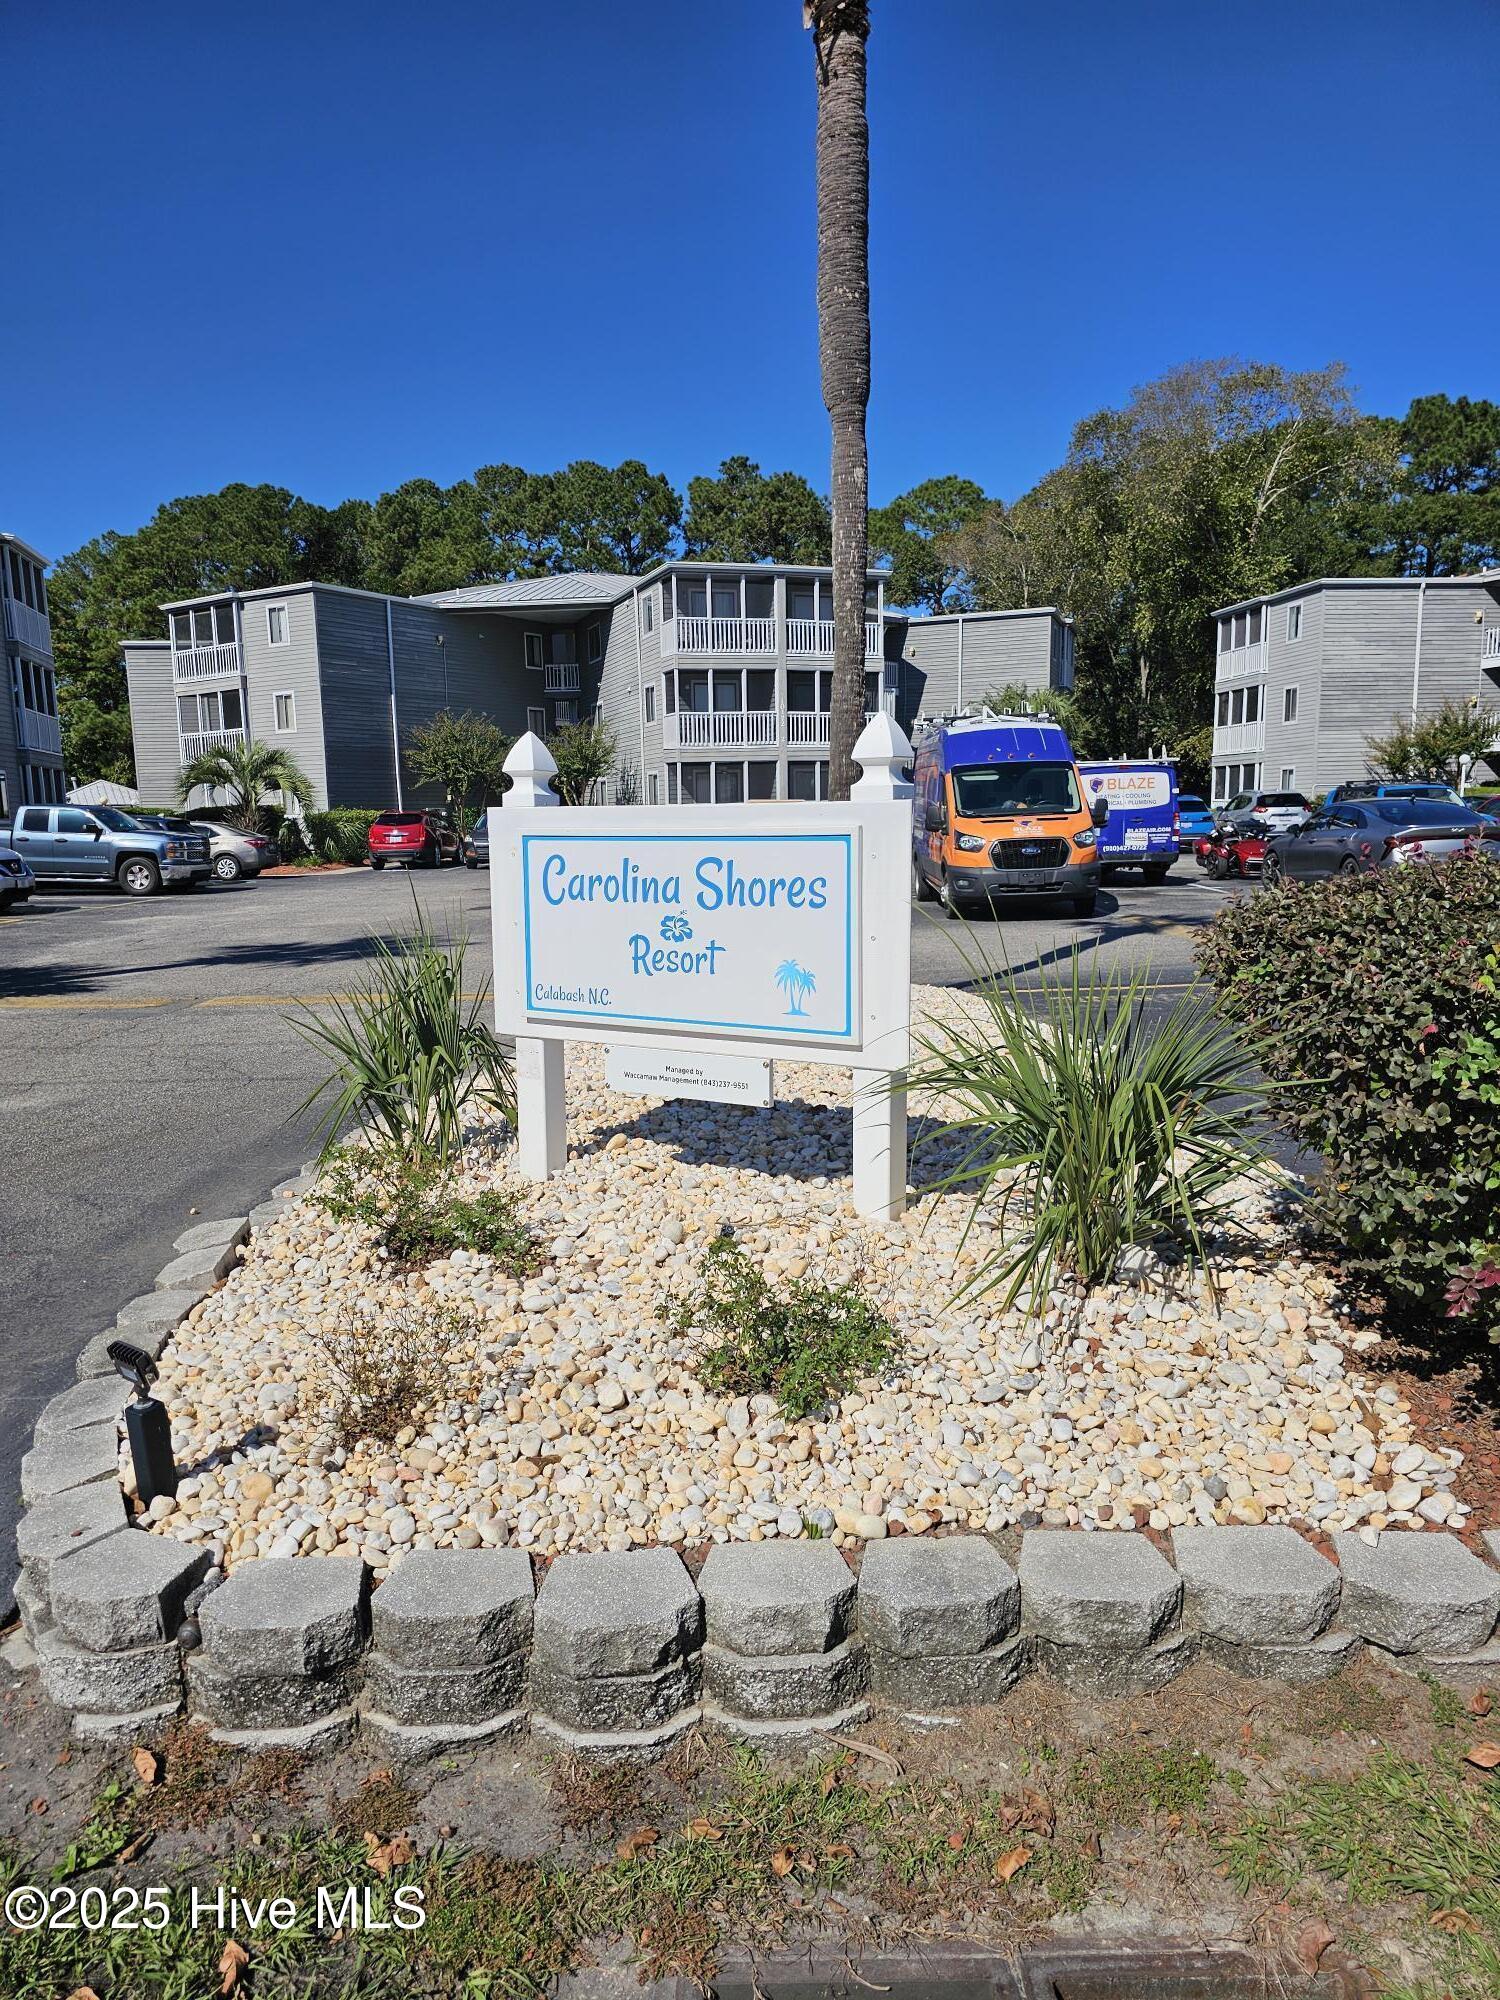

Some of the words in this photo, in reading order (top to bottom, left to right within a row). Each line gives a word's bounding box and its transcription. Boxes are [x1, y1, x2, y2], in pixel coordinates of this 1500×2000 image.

[1107, 777, 1156, 790] BLAZE
[542, 854, 681, 906] Carolina
[695, 856, 828, 911] Shores
[628, 933, 726, 976] Resort
[535, 983, 585, 1003] Calabash
[588, 987, 612, 1006] N.C.
[624, 1071, 658, 1081] Waccamaw
[659, 1075, 700, 1085] Management
[700, 1079, 749, 1091] (843)237-9551
[665, 1065, 694, 1075] Managed
[695, 1068, 703, 1077] by
